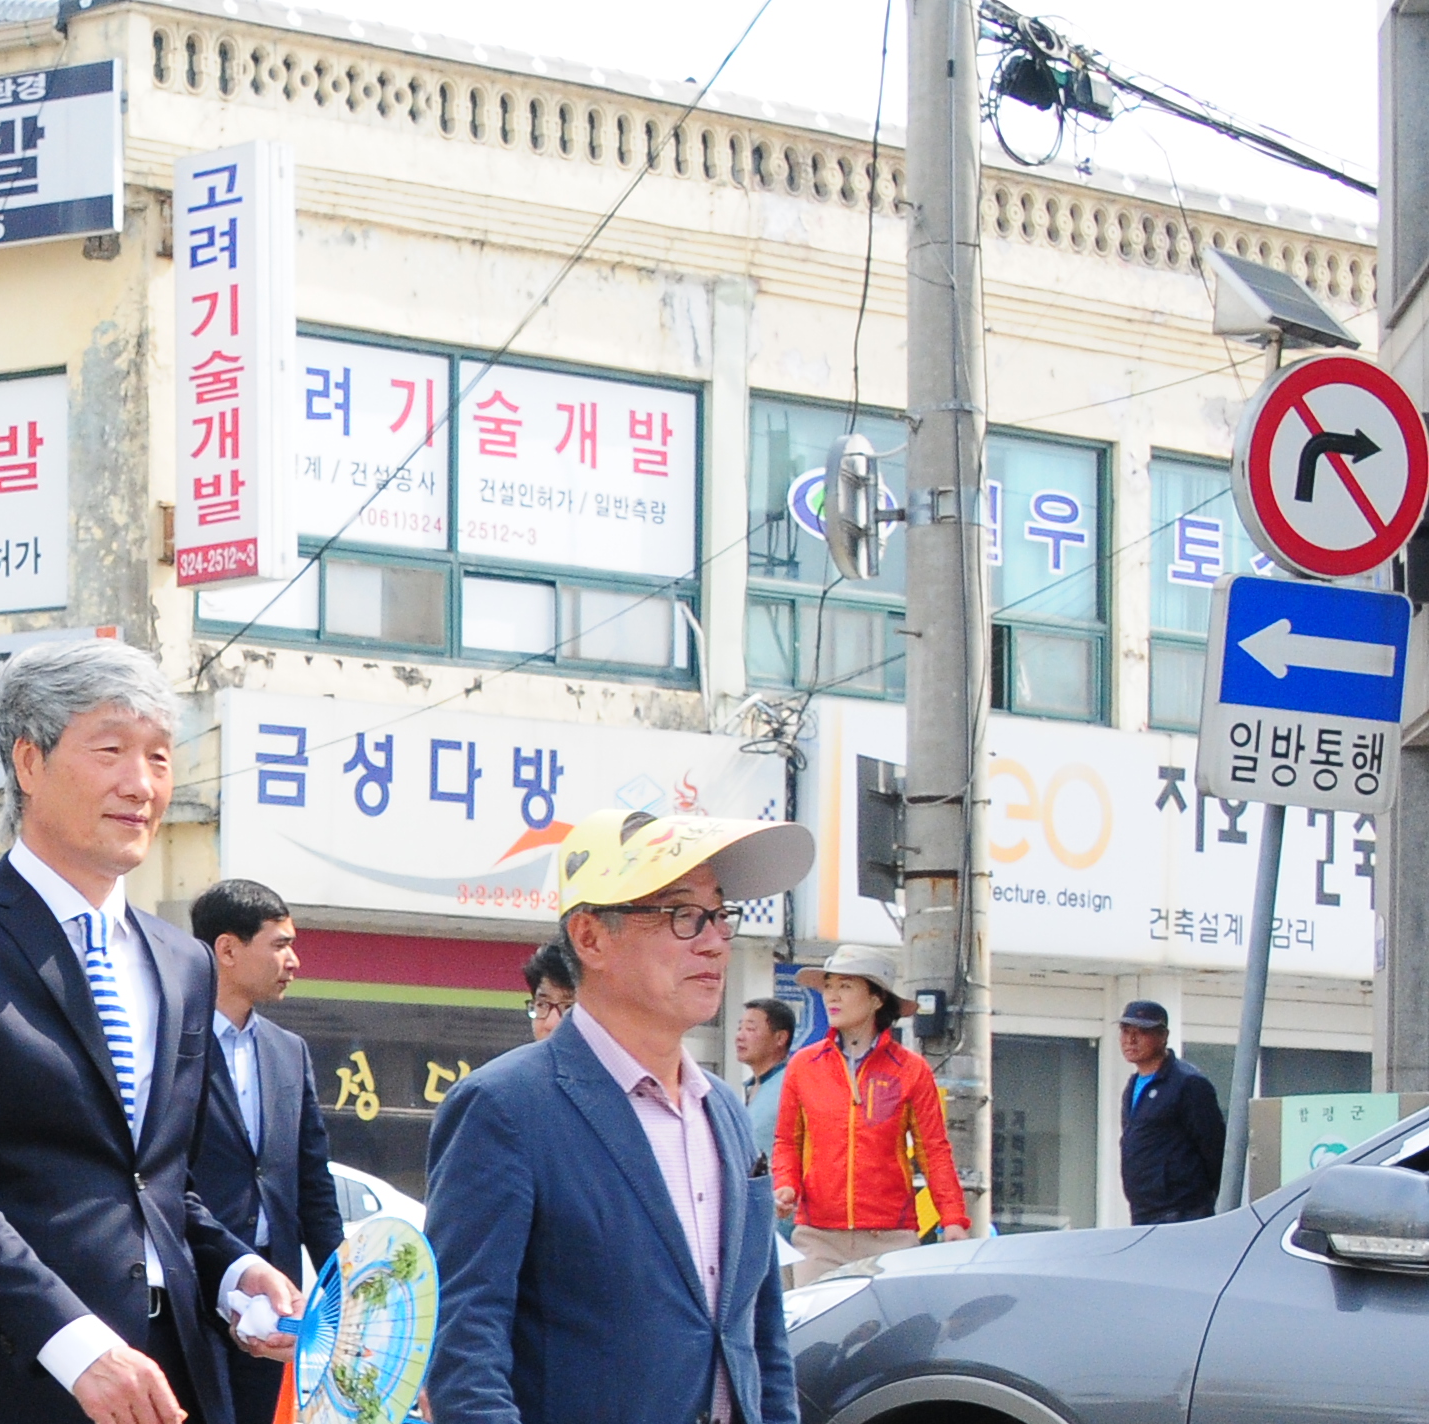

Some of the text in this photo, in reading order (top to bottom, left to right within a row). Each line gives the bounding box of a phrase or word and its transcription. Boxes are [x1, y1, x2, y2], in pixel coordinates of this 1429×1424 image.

[305, 366, 352, 438] 려
[295, 453, 322, 482] 계
[479, 478, 573, 515] 건설인허가
[595, 493, 667, 525] 일반측량
[255, 723, 565, 830] 금성다방
[1230, 719, 1385, 796] 일방통행
[989, 757, 1113, 870] eo
[992, 883, 1112, 913] ecture. design
[1149, 907, 1315, 952] 건축설계 감리
[1298, 1104, 1365, 1123] 함평군
